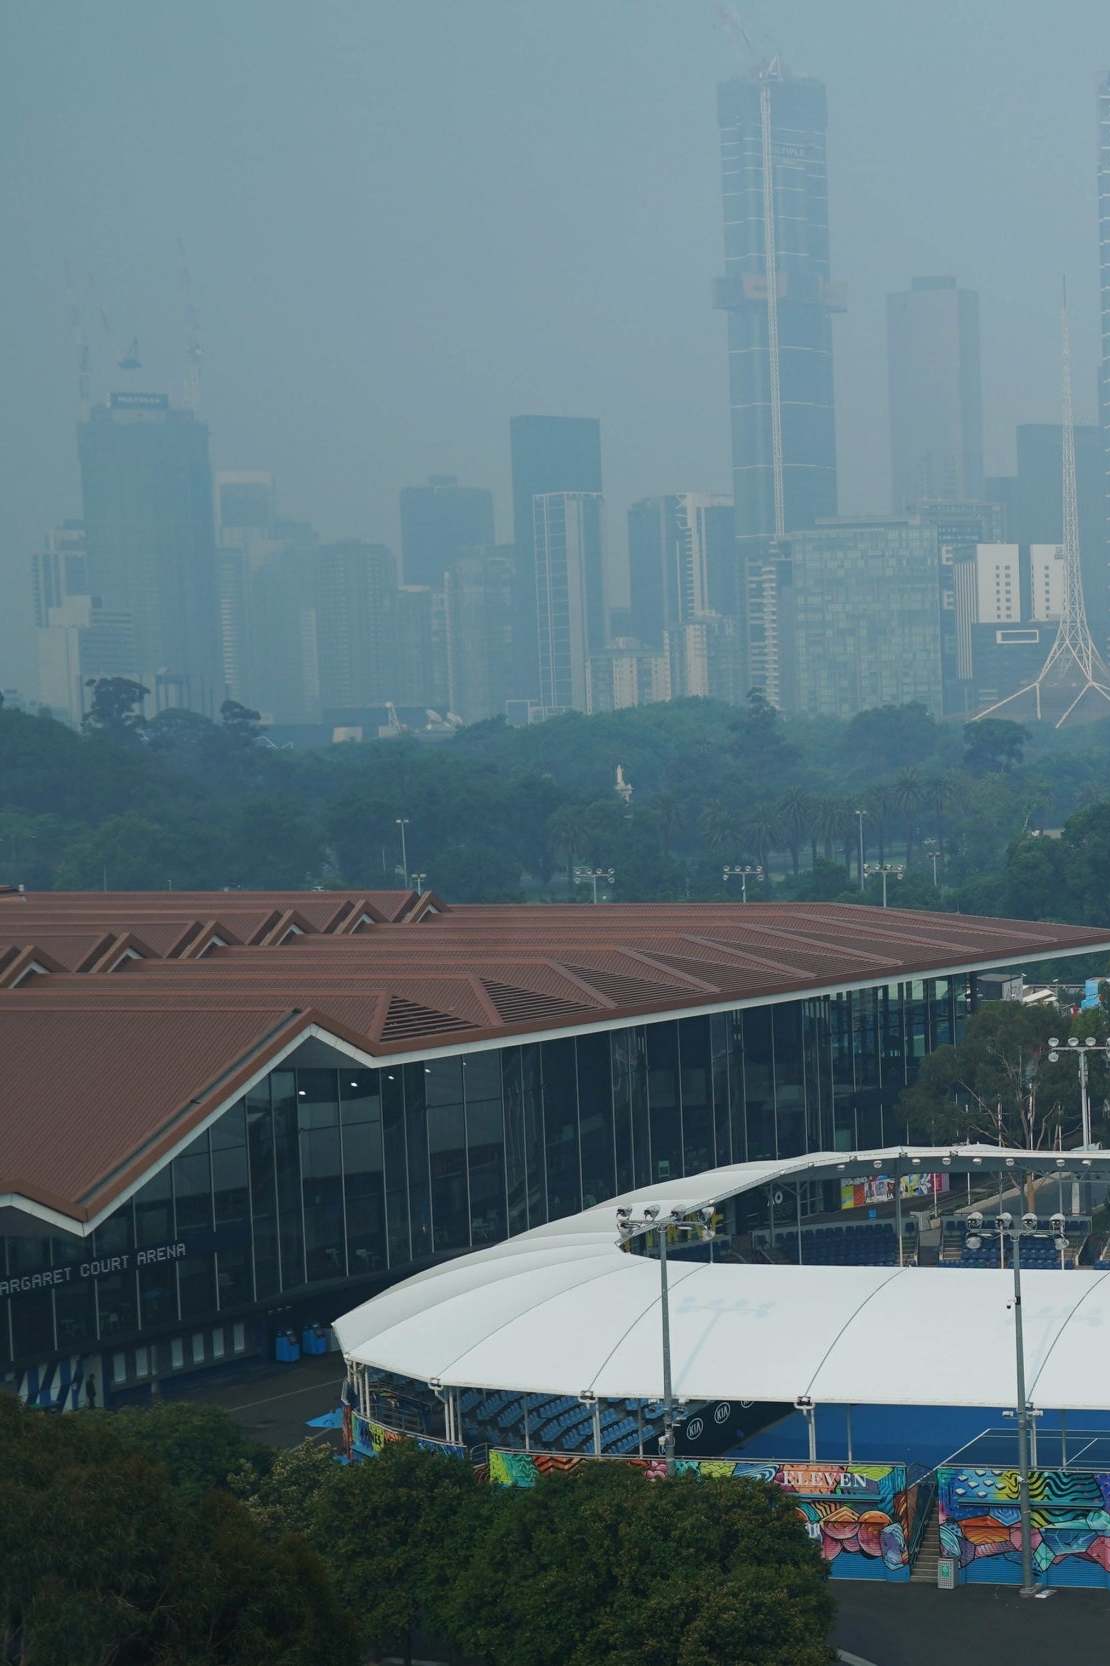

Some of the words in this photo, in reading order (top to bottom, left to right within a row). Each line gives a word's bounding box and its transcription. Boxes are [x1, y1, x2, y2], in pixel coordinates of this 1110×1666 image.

[80, 1255, 129, 1277] COURT
[137, 1242, 187, 1265] ARENA
[783, 1471, 867, 1488] ELEVEN
